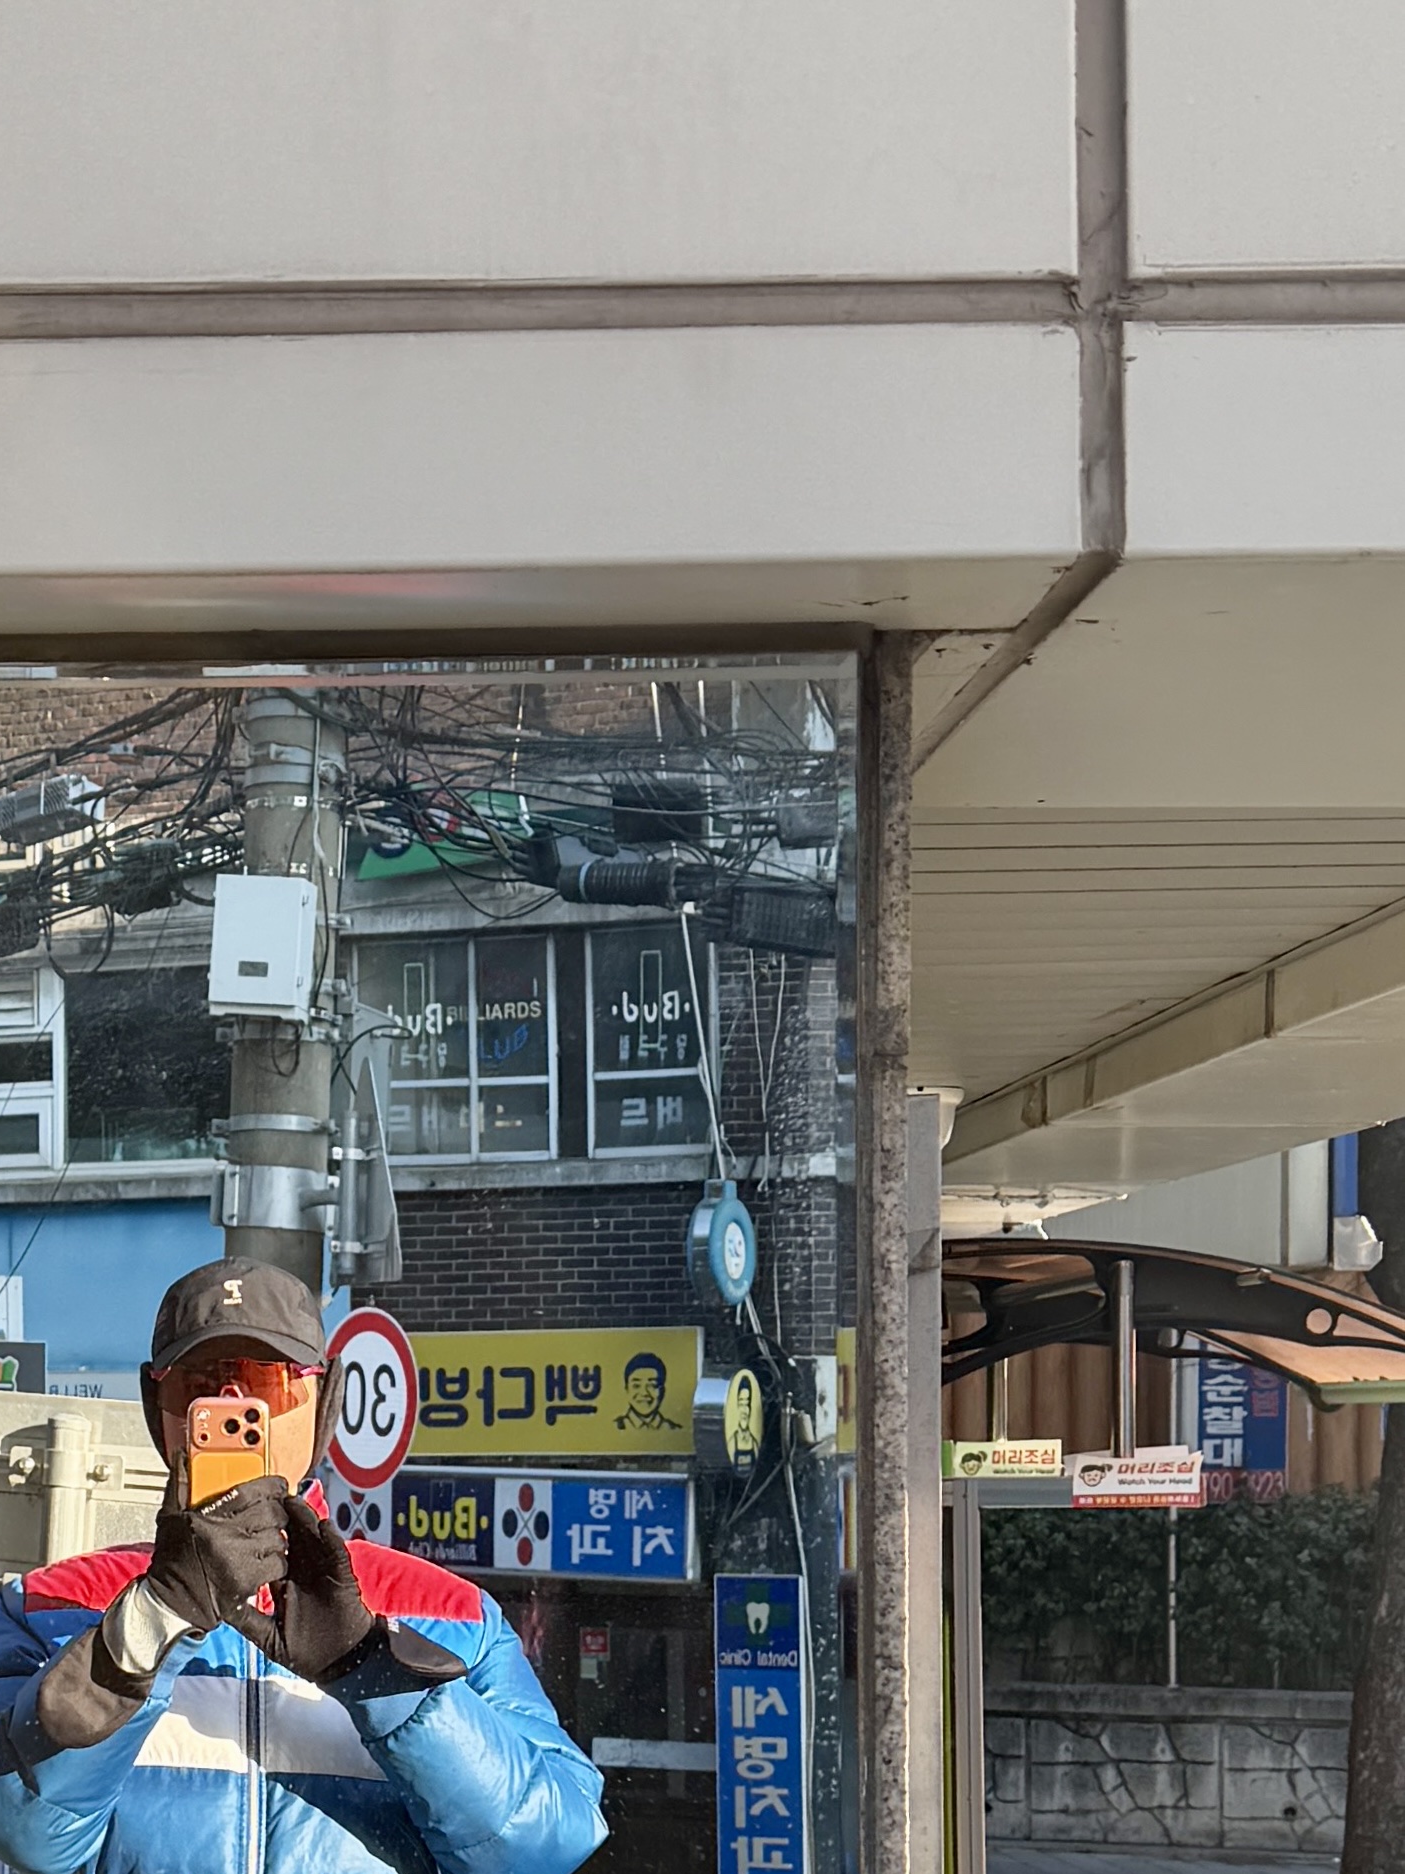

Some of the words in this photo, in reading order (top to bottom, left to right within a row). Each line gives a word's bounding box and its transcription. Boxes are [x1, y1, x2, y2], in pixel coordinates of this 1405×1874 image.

[991, 1448, 1057, 1466] 머리조심
[1117, 1459, 1195, 1476] 머리조심
[1117, 1477, 1145, 1487] Watch
[1147, 1477, 1168, 1486] Your
[1169, 1475, 1194, 1486] Head
